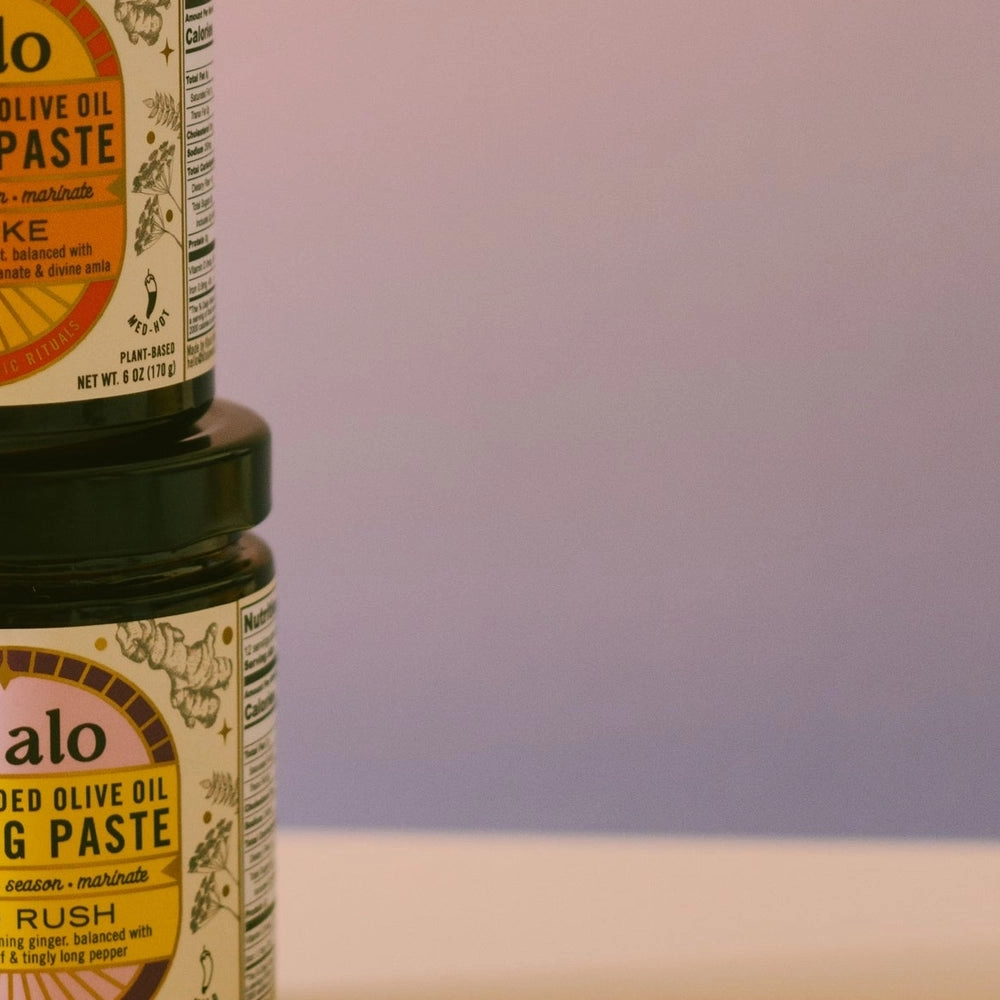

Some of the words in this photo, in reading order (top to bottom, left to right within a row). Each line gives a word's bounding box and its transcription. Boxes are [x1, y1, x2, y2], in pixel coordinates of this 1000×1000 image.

[77, 91, 113, 118] OIL
[22, 185, 94, 202] marinate
[12, 245, 65, 261] balanced
[69, 243, 93, 258] with
[35, 264, 44, 278] &
[48, 262, 81, 277] divine
[85, 259, 111, 274] amla
[127, 309, 170, 336] MED-HOT
[25, 319, 80, 366] RITUALS
[120, 342, 175, 364] PLANT-BASED
[77, 374, 98, 390] NET
[101, 371, 119, 387] WT.
[123, 369, 129, 384] 6
[132, 367, 144, 382] OZ
[147, 363, 166, 381] (170
[168, 360, 176, 378] g)
[53, 781, 123, 811] OLIVE
[132, 776, 168, 804] OIL
[50, 807, 171, 858] PASTE
[5, 878, 64, 893] season
[77, 866, 149, 890] marinate
[17, 902, 116, 929] RUSH
[73, 928, 126, 945] balanced
[129, 924, 153, 939] with
[9, 951, 18, 964] &
[22, 950, 56, 966] tingly
[60, 949, 85, 964] long
[89, 946, 128, 963] pepper
